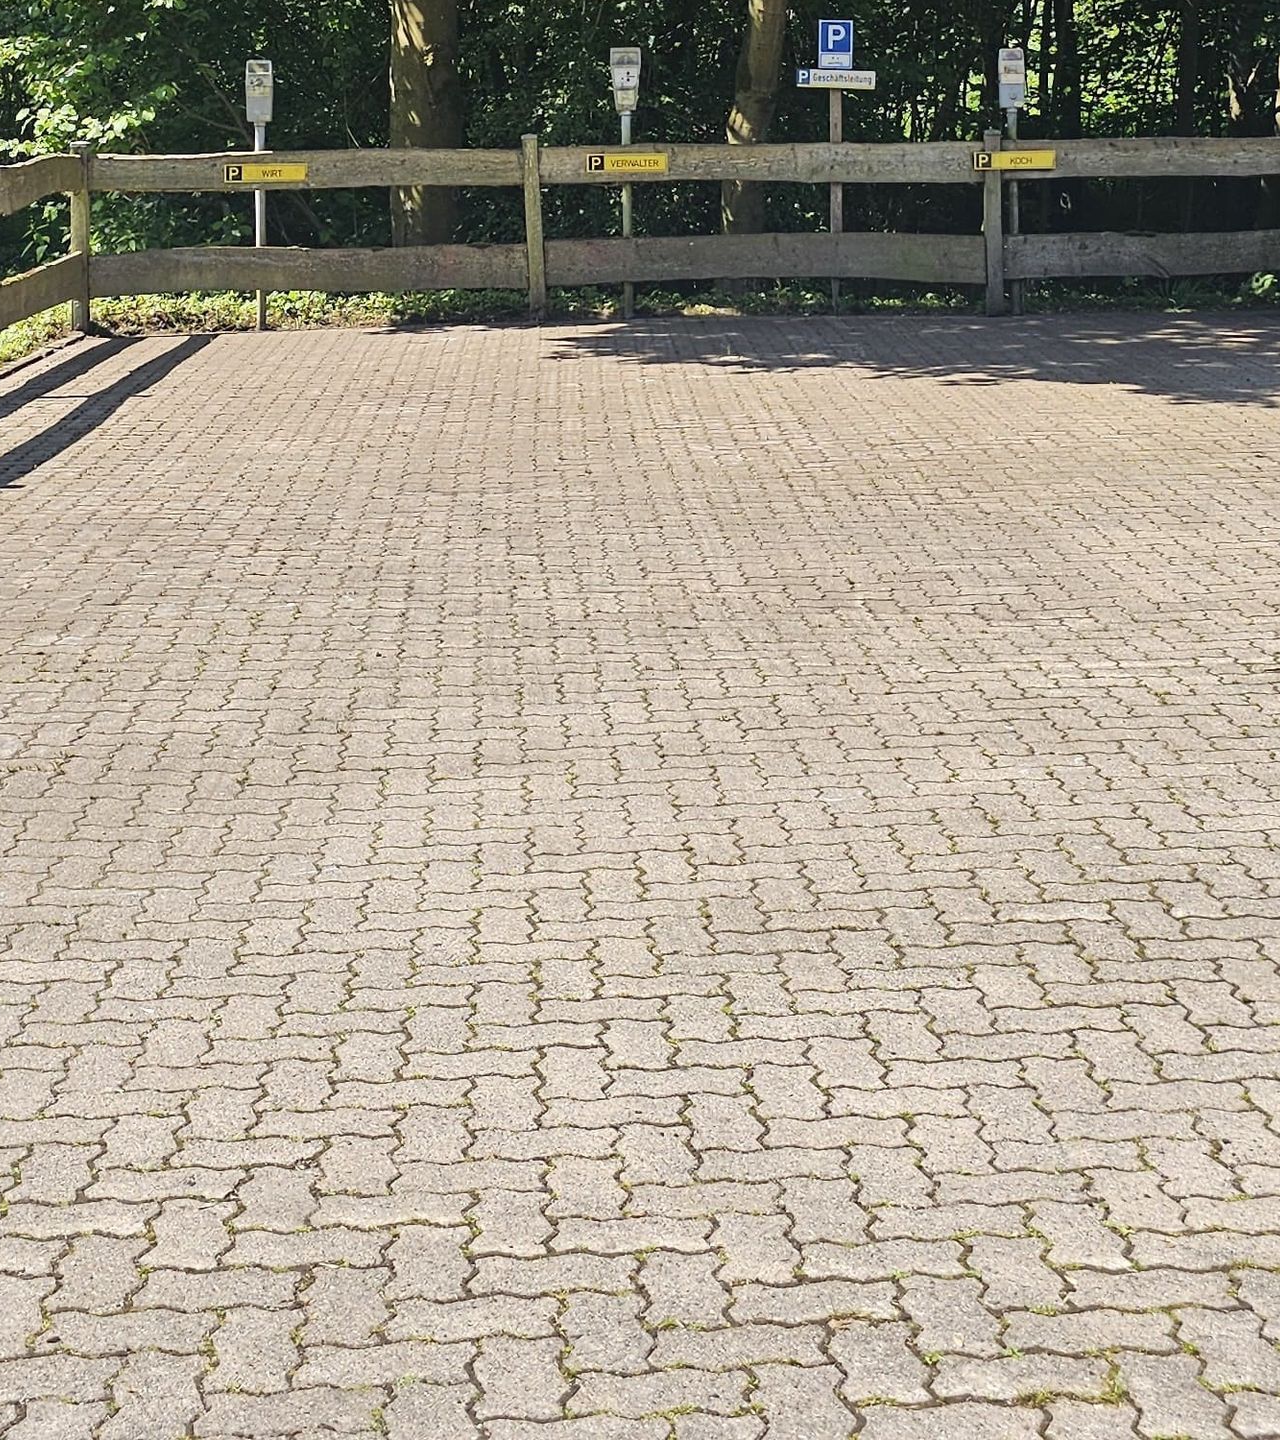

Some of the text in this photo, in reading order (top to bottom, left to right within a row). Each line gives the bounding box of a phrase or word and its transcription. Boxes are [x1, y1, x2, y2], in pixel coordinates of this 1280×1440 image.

[827, 24, 846, 50] P
[798, 70, 809, 83] P
[591, 157, 659, 170] P VERWALTER
[978, 155, 1033, 167] P KOCH
[228, 167, 283, 181] P WIRT
